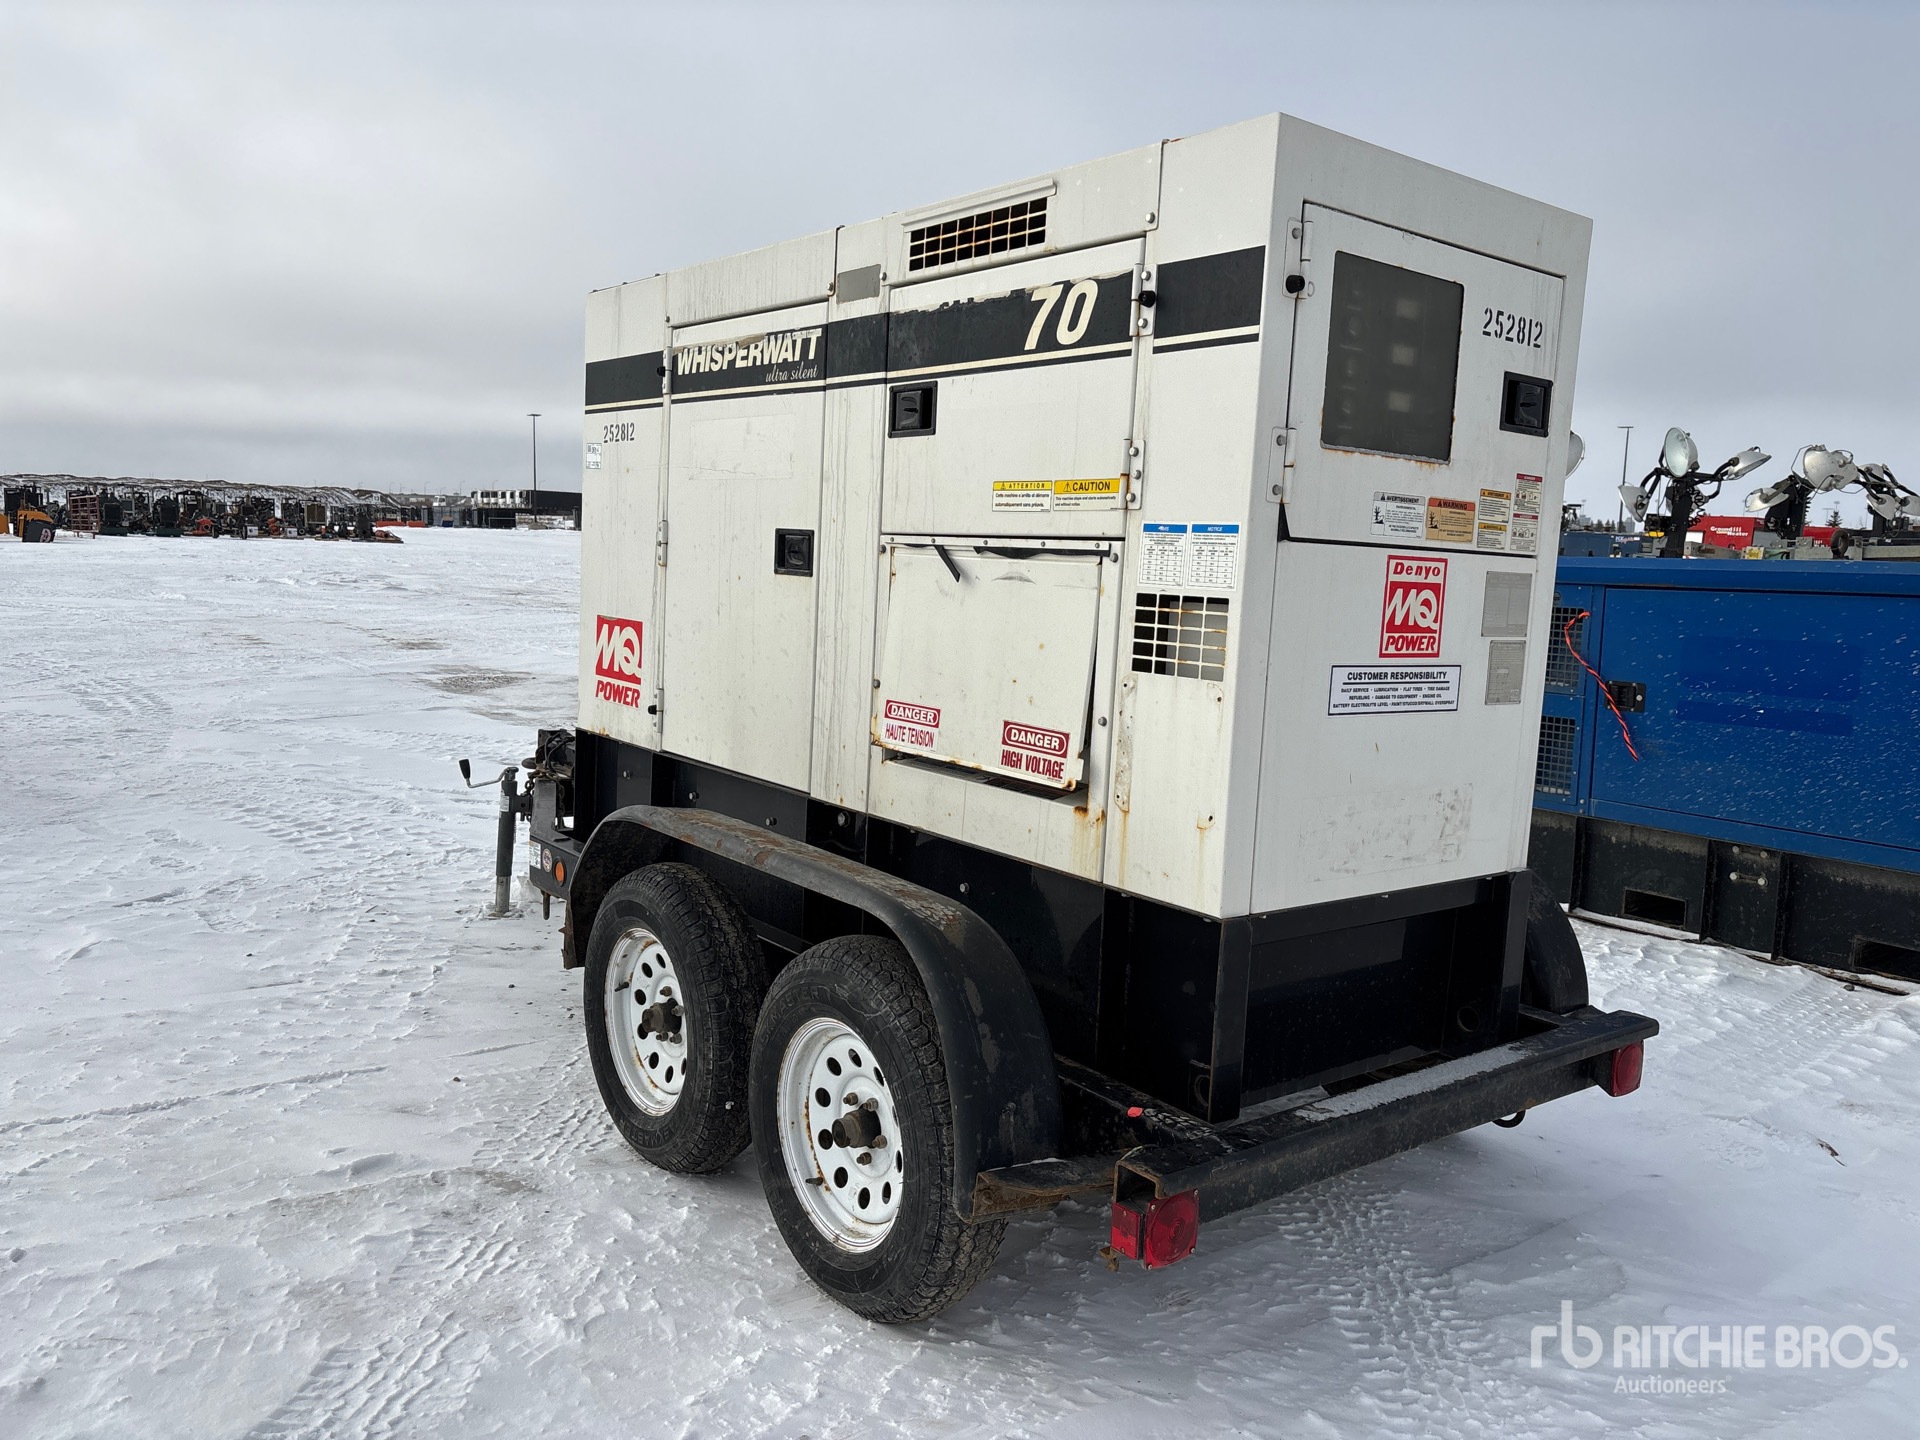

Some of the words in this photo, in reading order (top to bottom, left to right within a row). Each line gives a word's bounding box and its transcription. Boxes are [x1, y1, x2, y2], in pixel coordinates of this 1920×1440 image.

[1024, 279, 1098, 350] 70
[1482, 307, 1542, 348] 252812
[678, 328, 822, 376] WHISPERWATT
[766, 364, 788, 382] ultra
[790, 361, 818, 381] silent
[604, 422, 635, 444] 252812
[1072, 481, 1110, 492] CAUTION
[1443, 502, 1467, 510] WARNING
[1393, 562, 1440, 580] Denyo
[1386, 588, 1438, 630] MQ
[596, 624, 641, 678] MQ
[1384, 635, 1436, 651] POWER
[1347, 672, 1388, 680] CUSTOMER
[1390, 671, 1447, 680] RESPONSIBILITY
[595, 680, 640, 708] POWER
[890, 706, 935, 723] DANGER
[884, 723, 906, 742] HAUTE
[907, 727, 934, 748] TENSION
[1010, 730, 1060, 750] DANGER
[1001, 749, 1023, 769] HIGH
[1025, 755, 1064, 780] VOLTAGE
